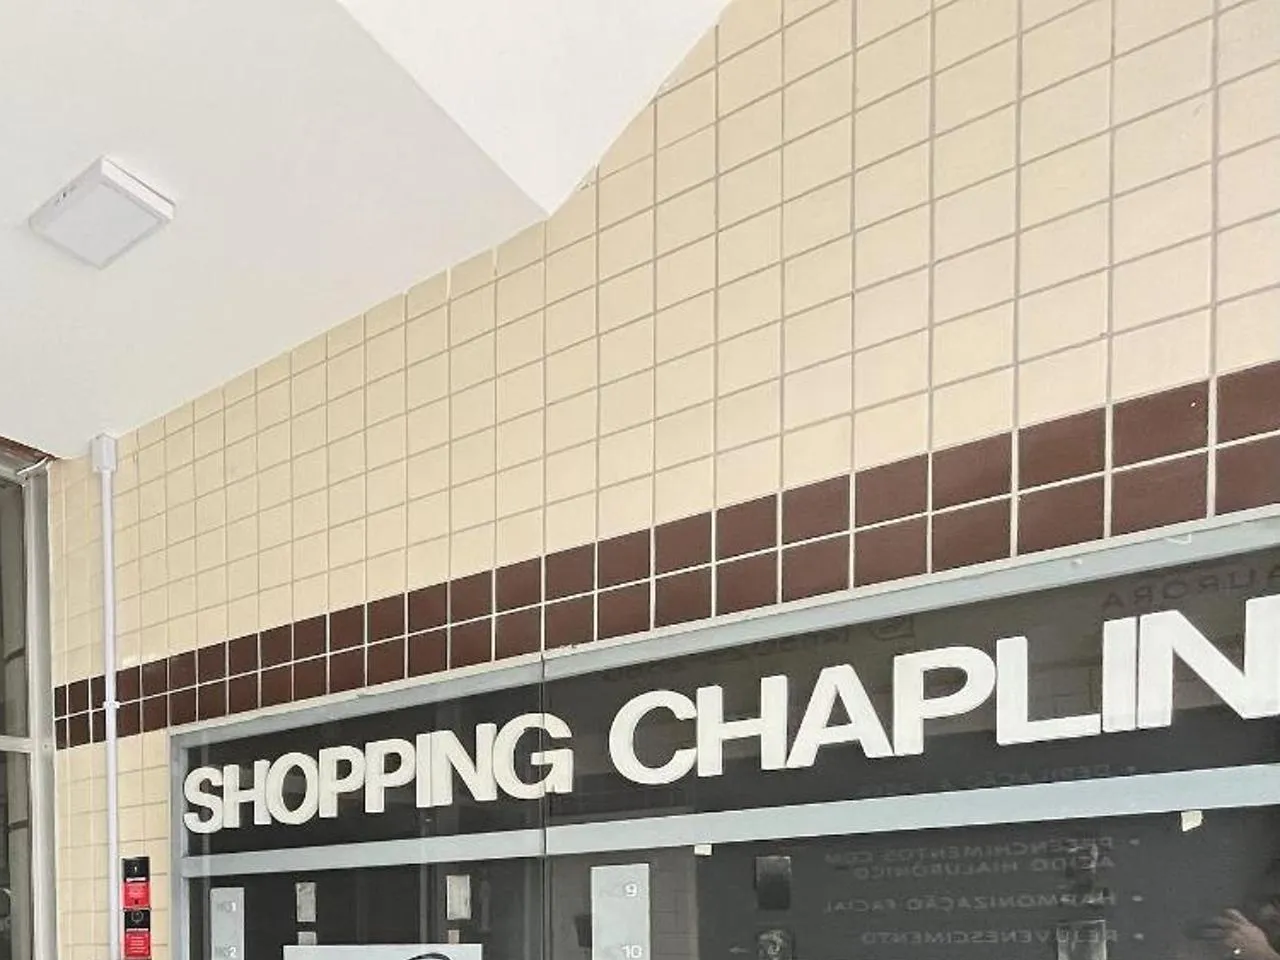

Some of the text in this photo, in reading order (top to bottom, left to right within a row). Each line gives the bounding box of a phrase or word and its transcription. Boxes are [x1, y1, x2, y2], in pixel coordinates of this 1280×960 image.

[182, 595, 1280, 836] SHOPPING CHAPLIN
[624, 884, 638, 898] 9
[622, 944, 643, 960] 10
